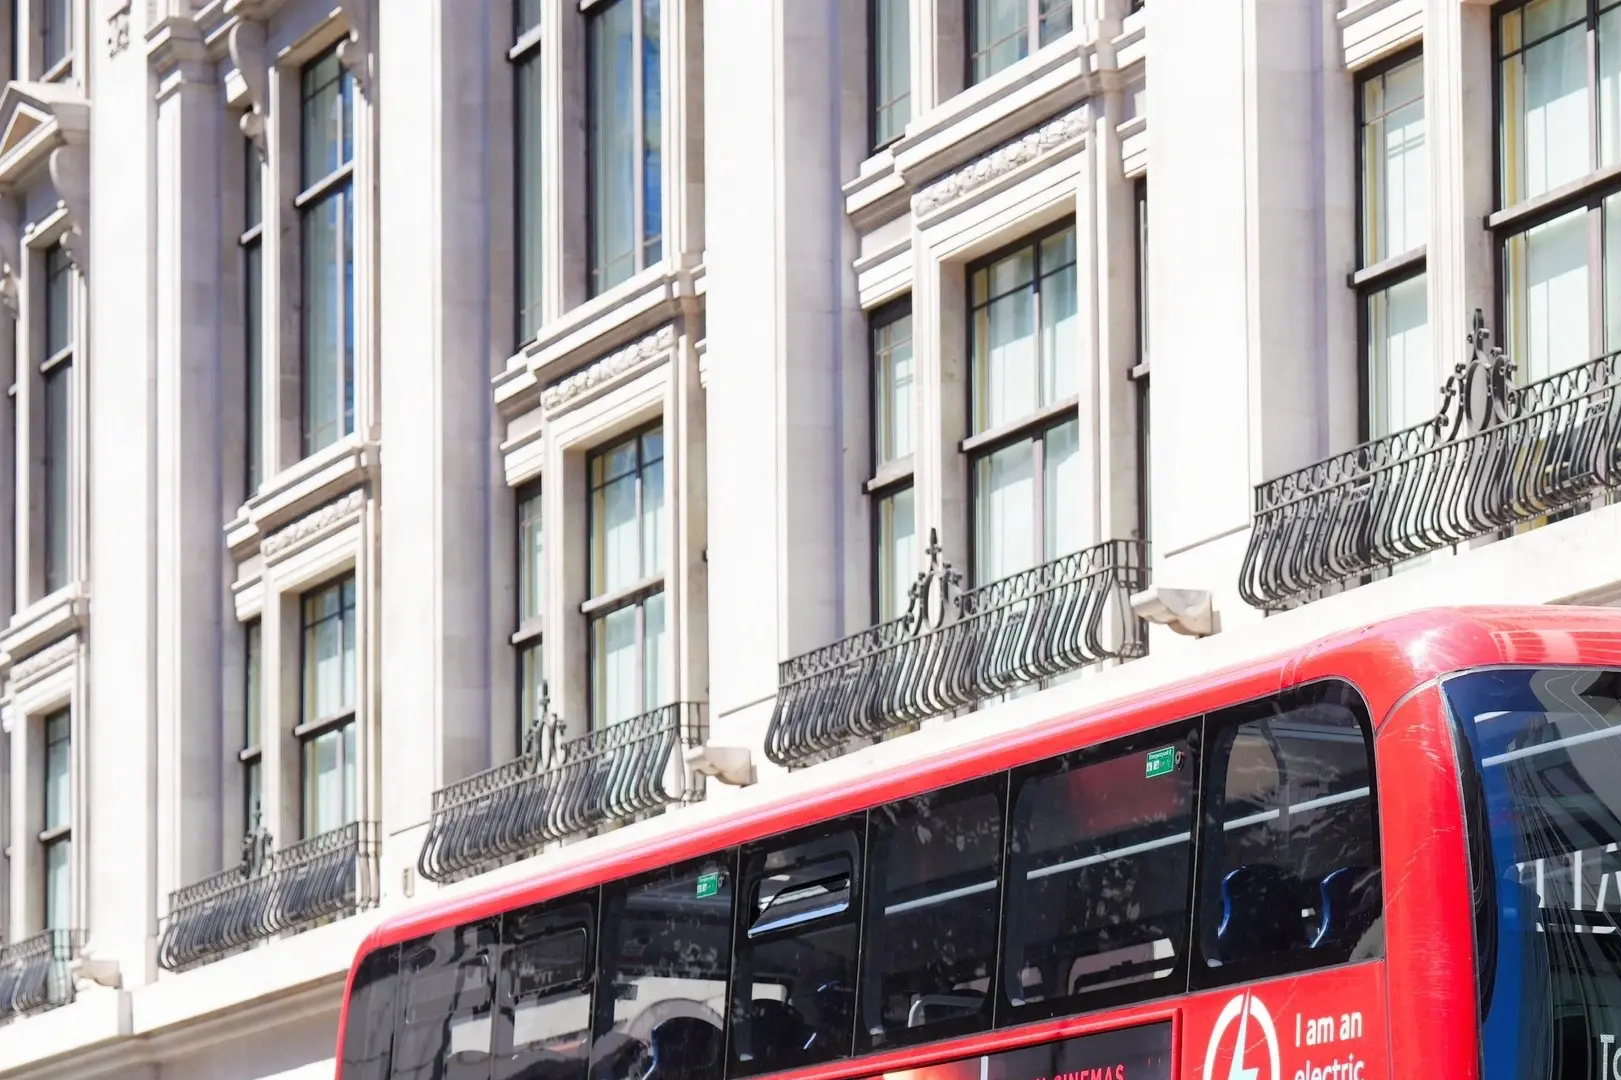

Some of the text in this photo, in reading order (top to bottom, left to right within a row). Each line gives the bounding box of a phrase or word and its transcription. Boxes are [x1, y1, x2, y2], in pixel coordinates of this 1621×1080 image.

[1295, 1011, 1362, 1048] I am an
